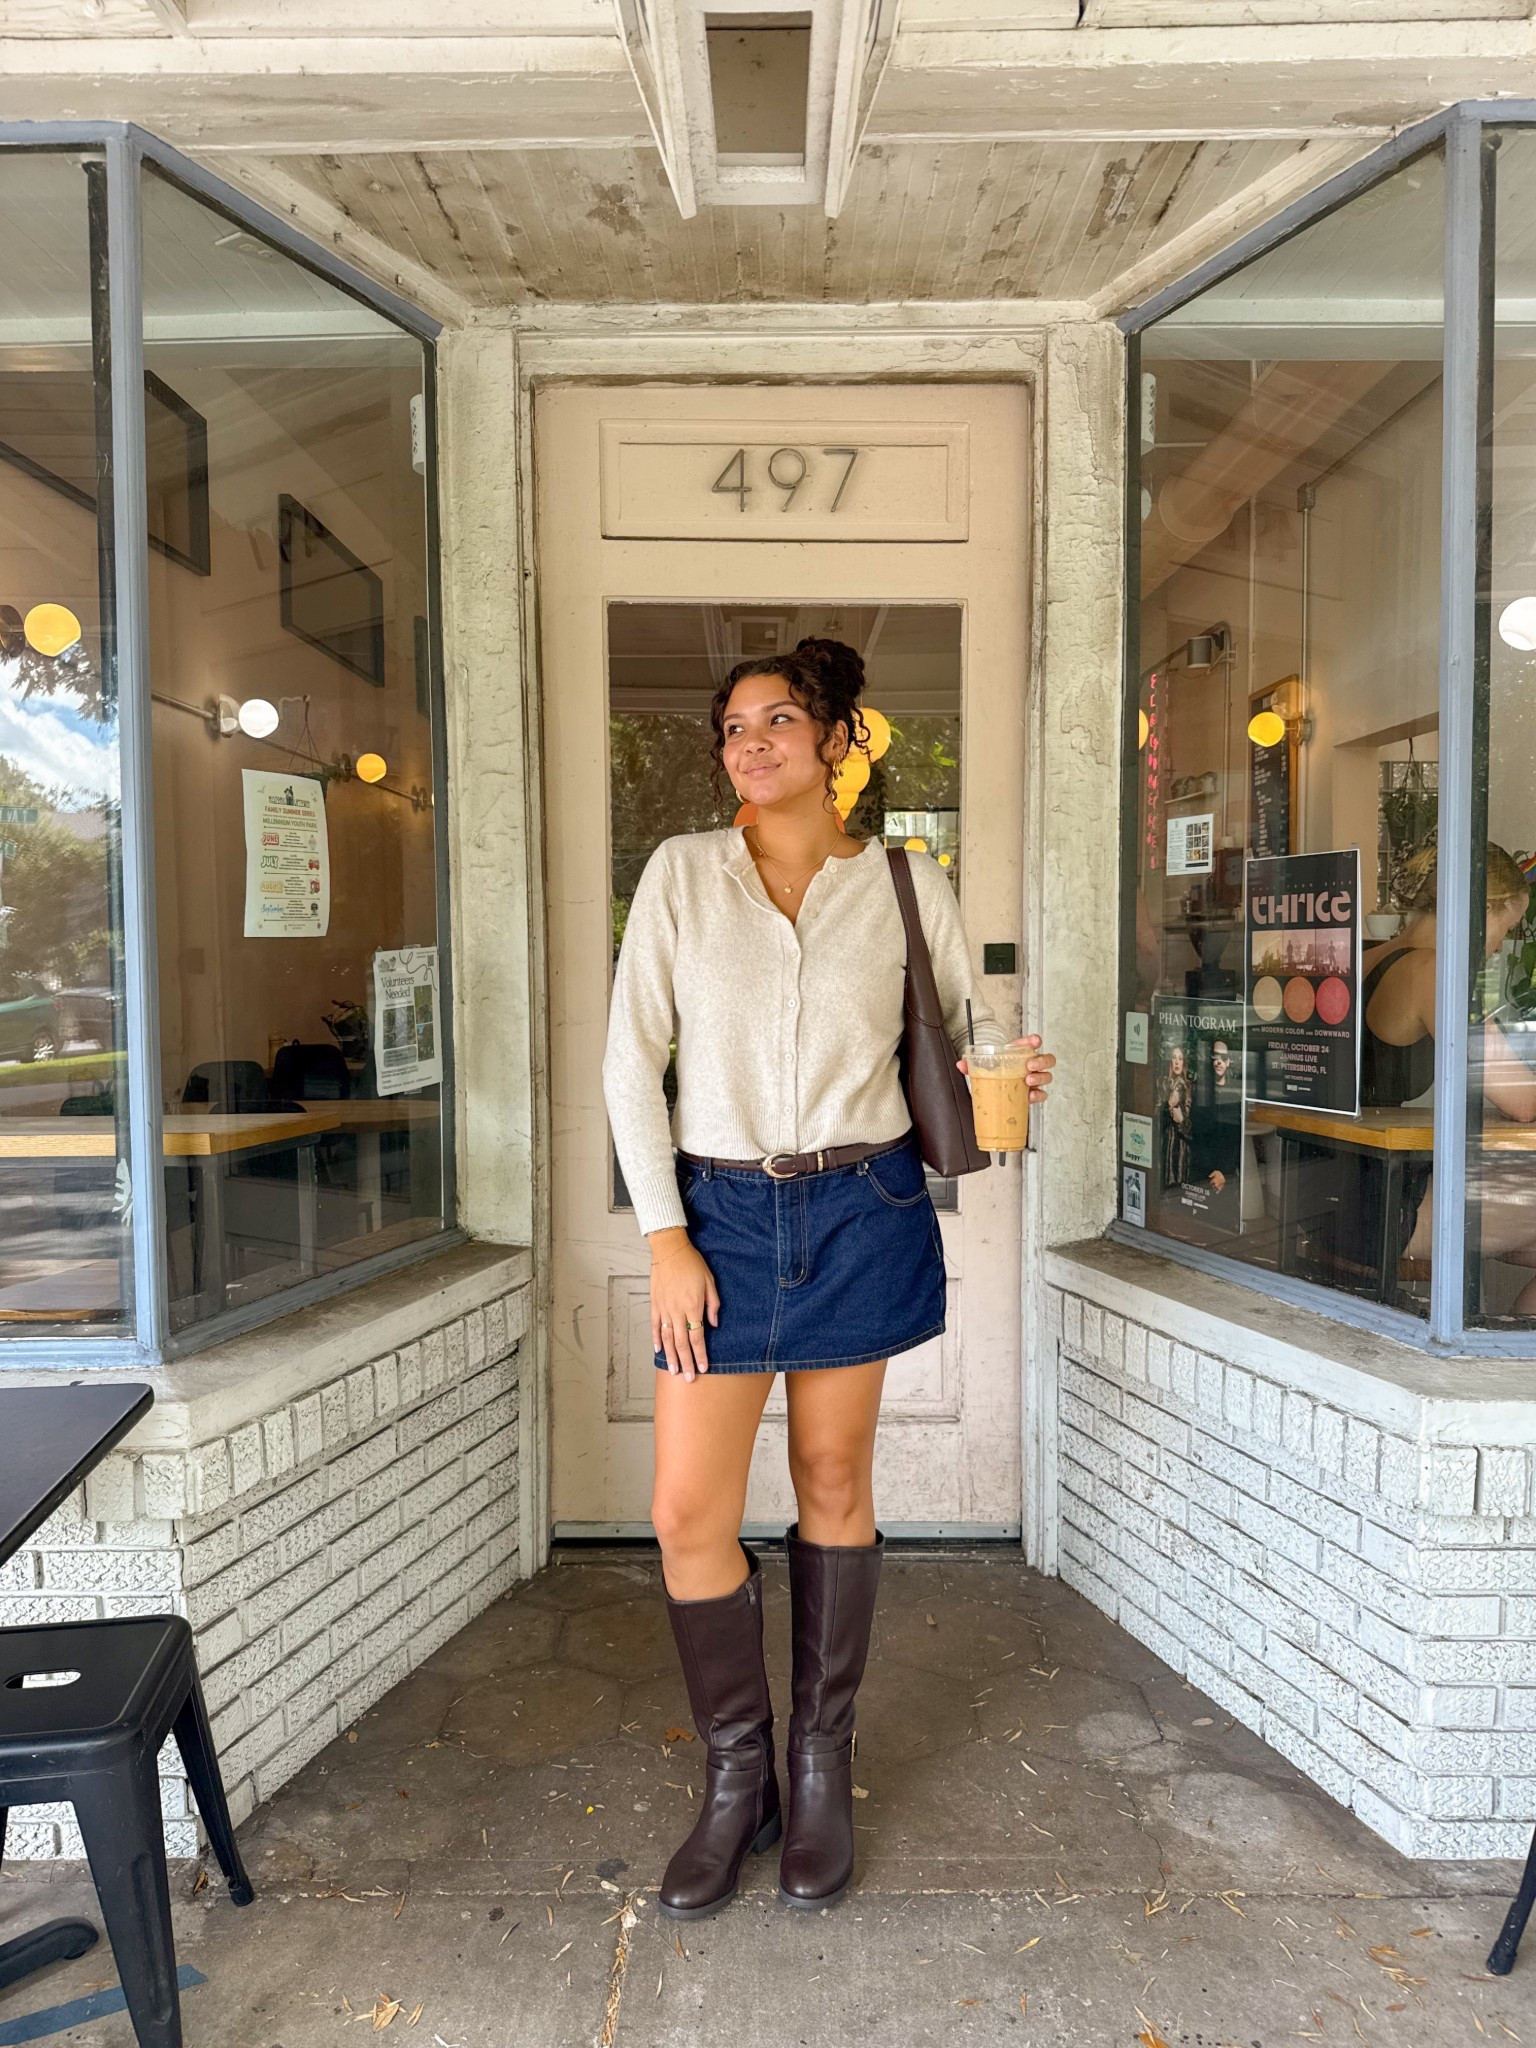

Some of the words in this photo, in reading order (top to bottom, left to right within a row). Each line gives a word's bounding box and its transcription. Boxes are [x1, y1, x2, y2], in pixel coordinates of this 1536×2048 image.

[711, 447, 858, 512] 497
[264, 806, 281, 814] FAMILY
[282, 808, 301, 816] SUMMER
[262, 818, 291, 826] MILLENNIUM
[291, 820, 306, 828] YOUTH
[262, 833, 279, 845] JUNE
[261, 855, 279, 869] JULY
[261, 881, 283, 892] AUGUST
[381, 977, 414, 988] Volunteers
[385, 986, 410, 1000] Needed
[1158, 1012, 1236, 1033] PHANTOGRAM
[1261, 1026, 1284, 1034] MODERN
[1285, 1027, 1305, 1035] COLOR
[1314, 1029, 1350, 1038] DOWNWARD
[1268, 1041, 1290, 1051] FRIDAY,
[1291, 1043, 1320, 1052] OCTOBER
[1320, 1045, 1329, 1053] 24
[1280, 1053, 1304, 1062] JANNUS
[1305, 1054, 1318, 1063] LIVE
[1272, 1062, 1280, 1070] ST.
[1281, 1063, 1319, 1074] PETERSBURG,
[1320, 1066, 1327, 1075] FL
[1181, 1182, 1204, 1194] OCTOBER
